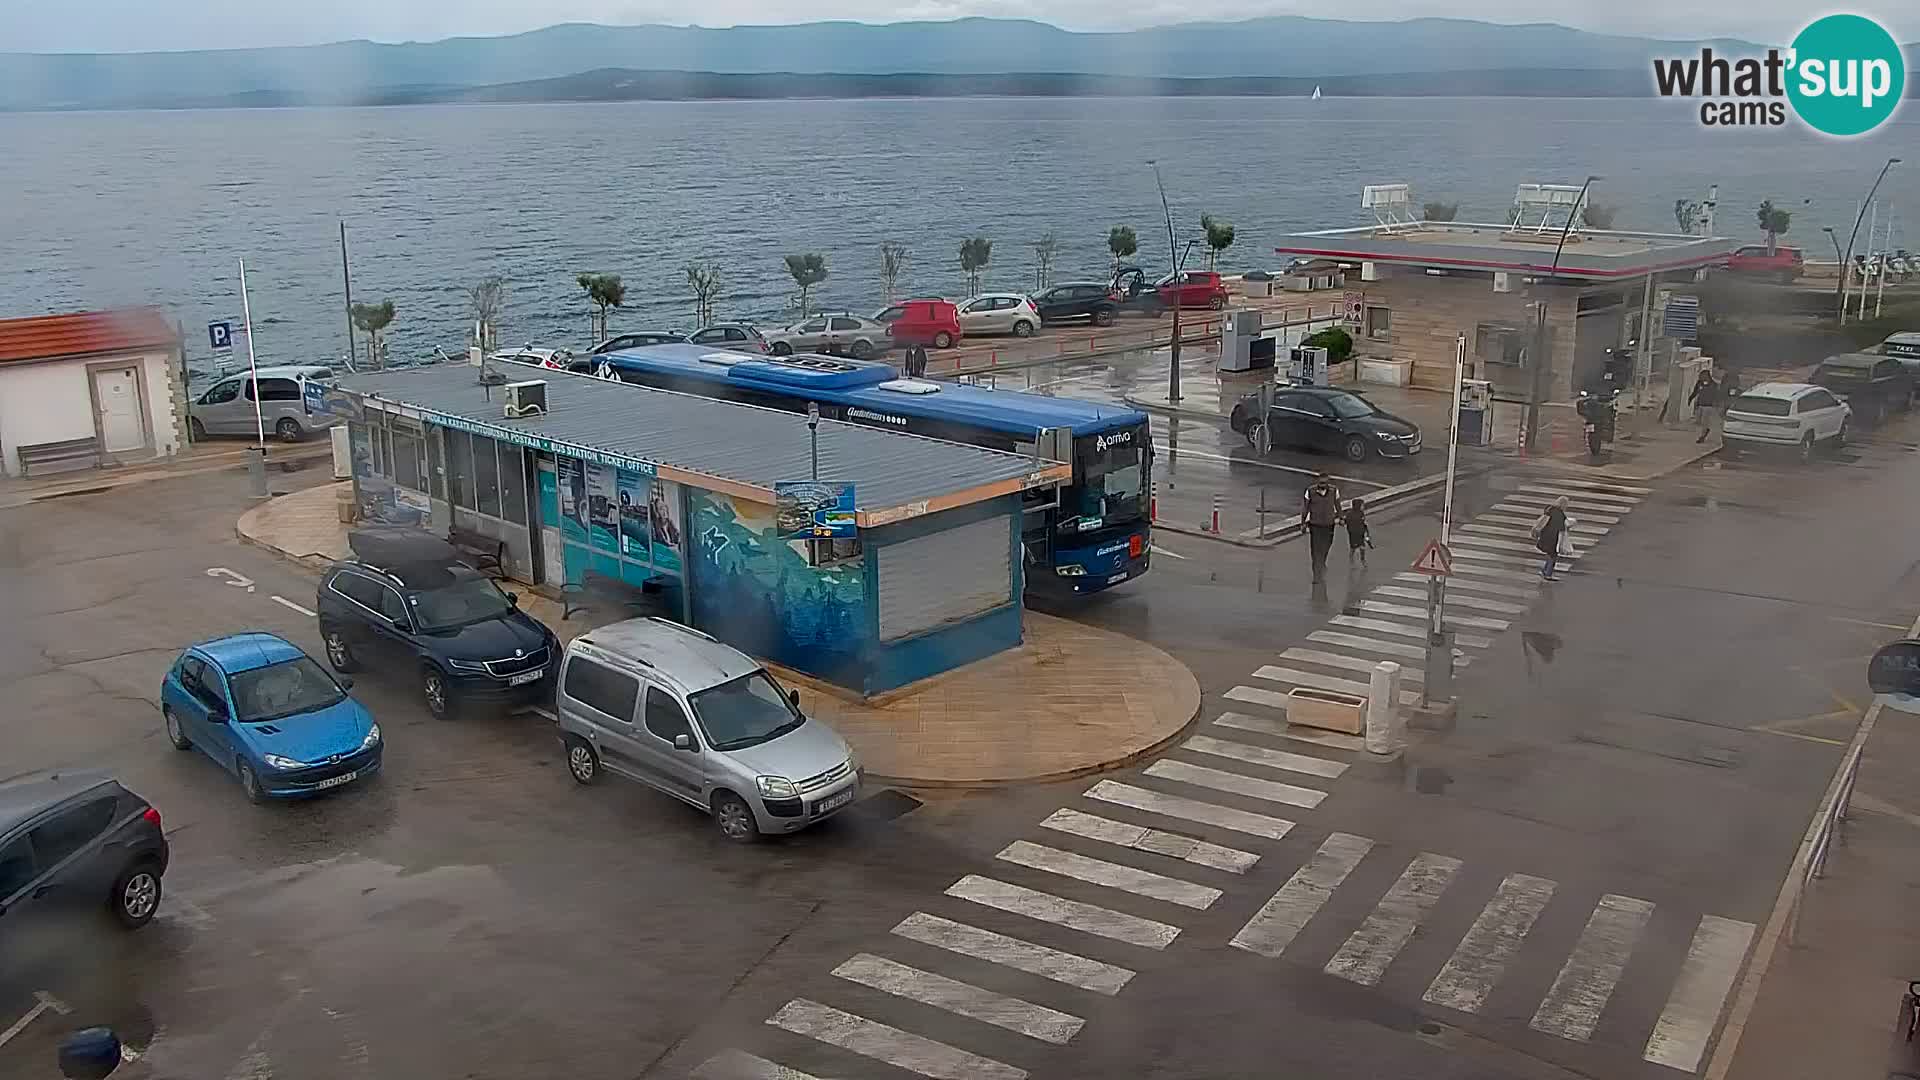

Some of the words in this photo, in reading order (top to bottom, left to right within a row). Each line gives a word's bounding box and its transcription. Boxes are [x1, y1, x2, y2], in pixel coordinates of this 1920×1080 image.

[214, 326, 226, 345] P
[1106, 431, 1131, 446] arriva
[471, 423, 509, 440] AUTOBUSKA
[511, 432, 540, 448] POSTAJA
[551, 442, 566, 454] BUS
[567, 446, 597, 461] STATION
[600, 454, 625, 467] TICKET
[627, 460, 653, 474] OFFICE
